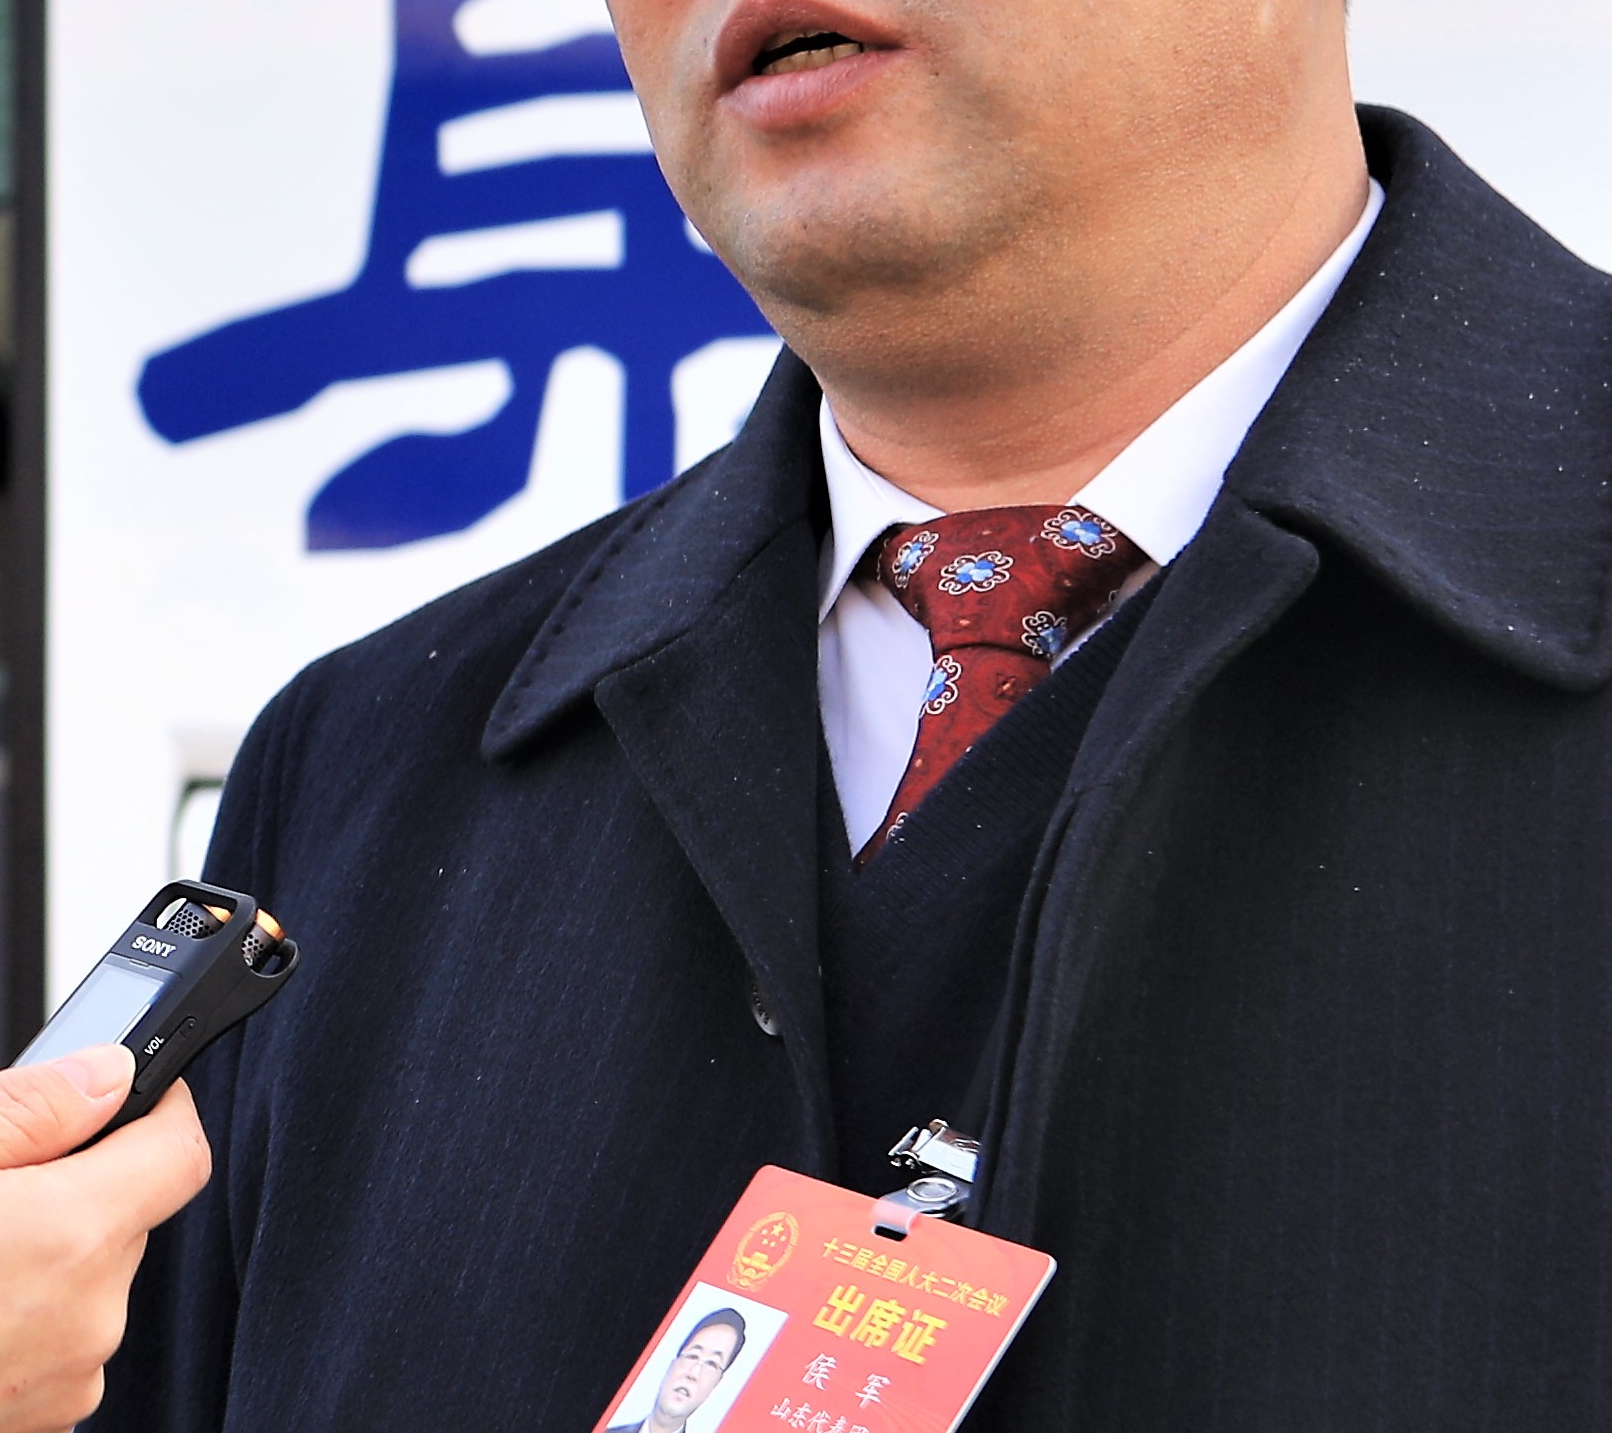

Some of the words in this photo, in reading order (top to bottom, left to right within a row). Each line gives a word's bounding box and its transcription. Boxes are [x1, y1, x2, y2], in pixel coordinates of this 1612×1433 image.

[131, 935, 176, 958] SONY
[144, 1036, 165, 1056] VOL
[822, 1237, 1010, 1317] 十三届全国人大二次会议
[812, 1284, 949, 1366] 出席证
